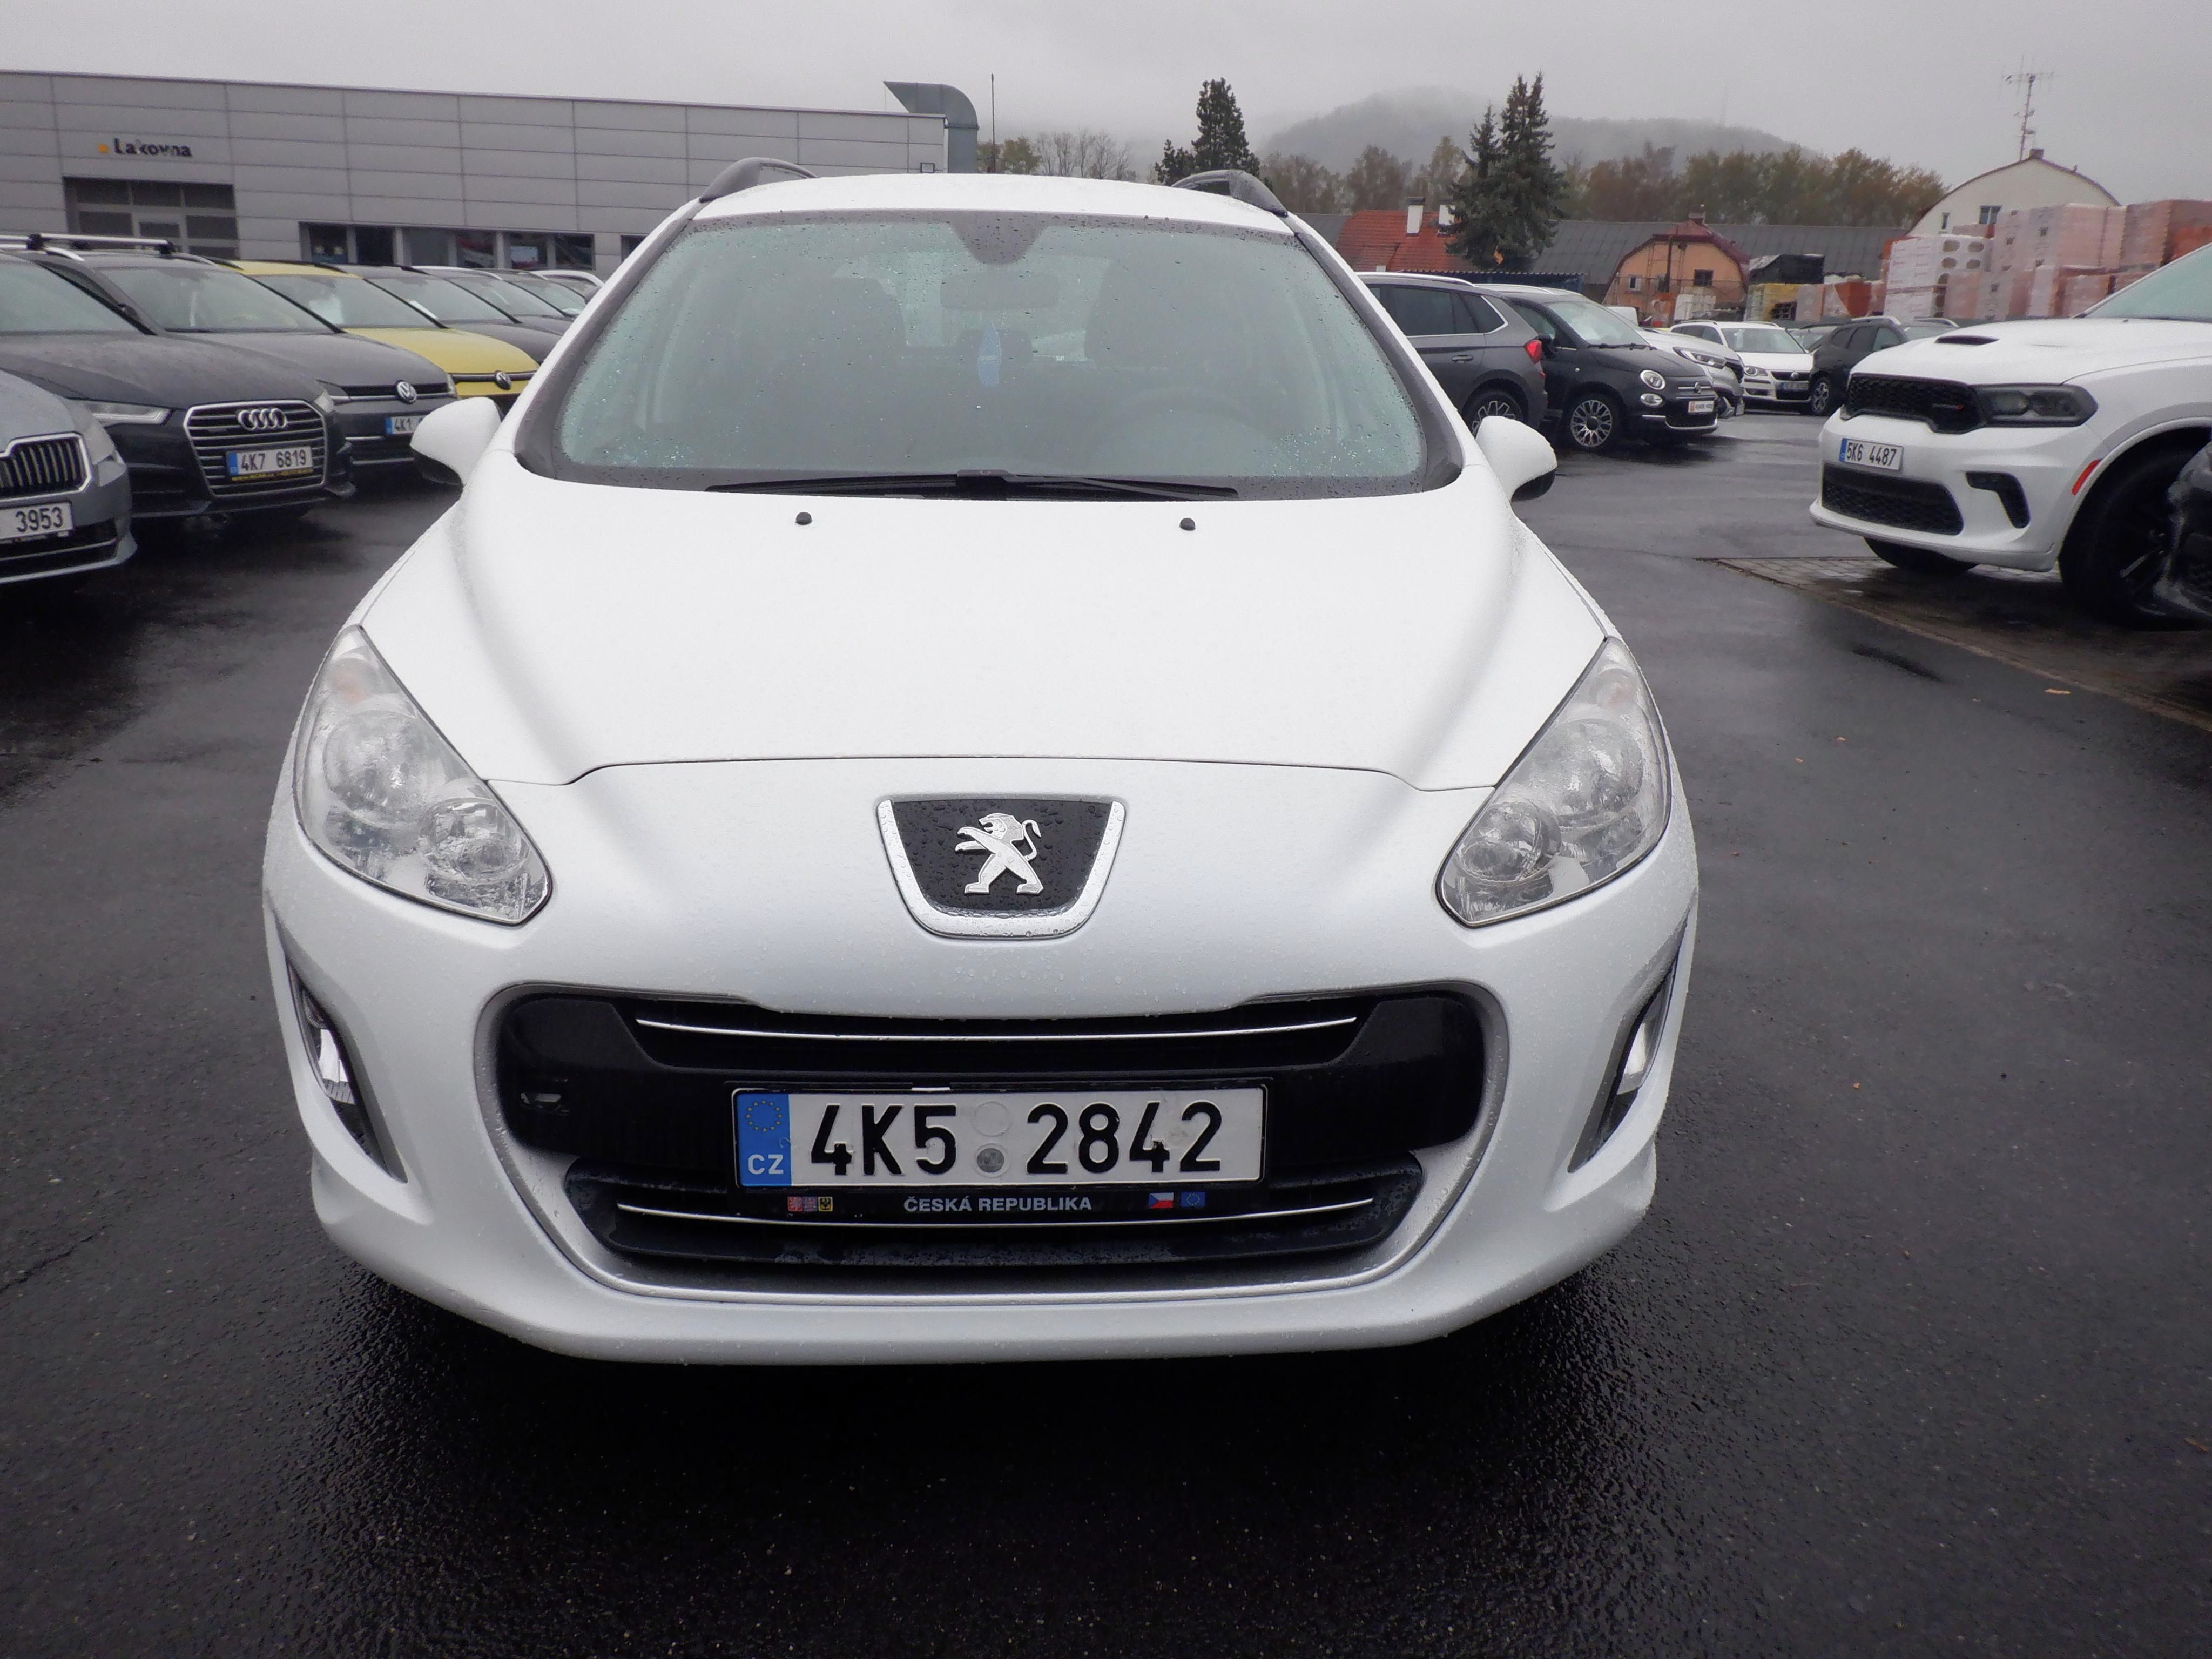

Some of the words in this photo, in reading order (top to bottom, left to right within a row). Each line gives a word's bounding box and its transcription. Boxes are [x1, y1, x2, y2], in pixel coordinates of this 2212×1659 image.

[114, 138, 193, 157] Lakovna
[241, 452, 265, 471] 4K7
[276, 449, 306, 468] 6819
[1847, 442, 1863, 461] 5K6
[1869, 446, 1897, 467] 4487
[15, 506, 63, 533] 3953
[811, 1103, 957, 1176] 4K5
[1026, 1100, 1222, 1175] 2842
[748, 1154, 784, 1175] CZ
[903, 1195, 972, 1212] ČESKÁ
[978, 1196, 1092, 1212] REPUBLIKA
